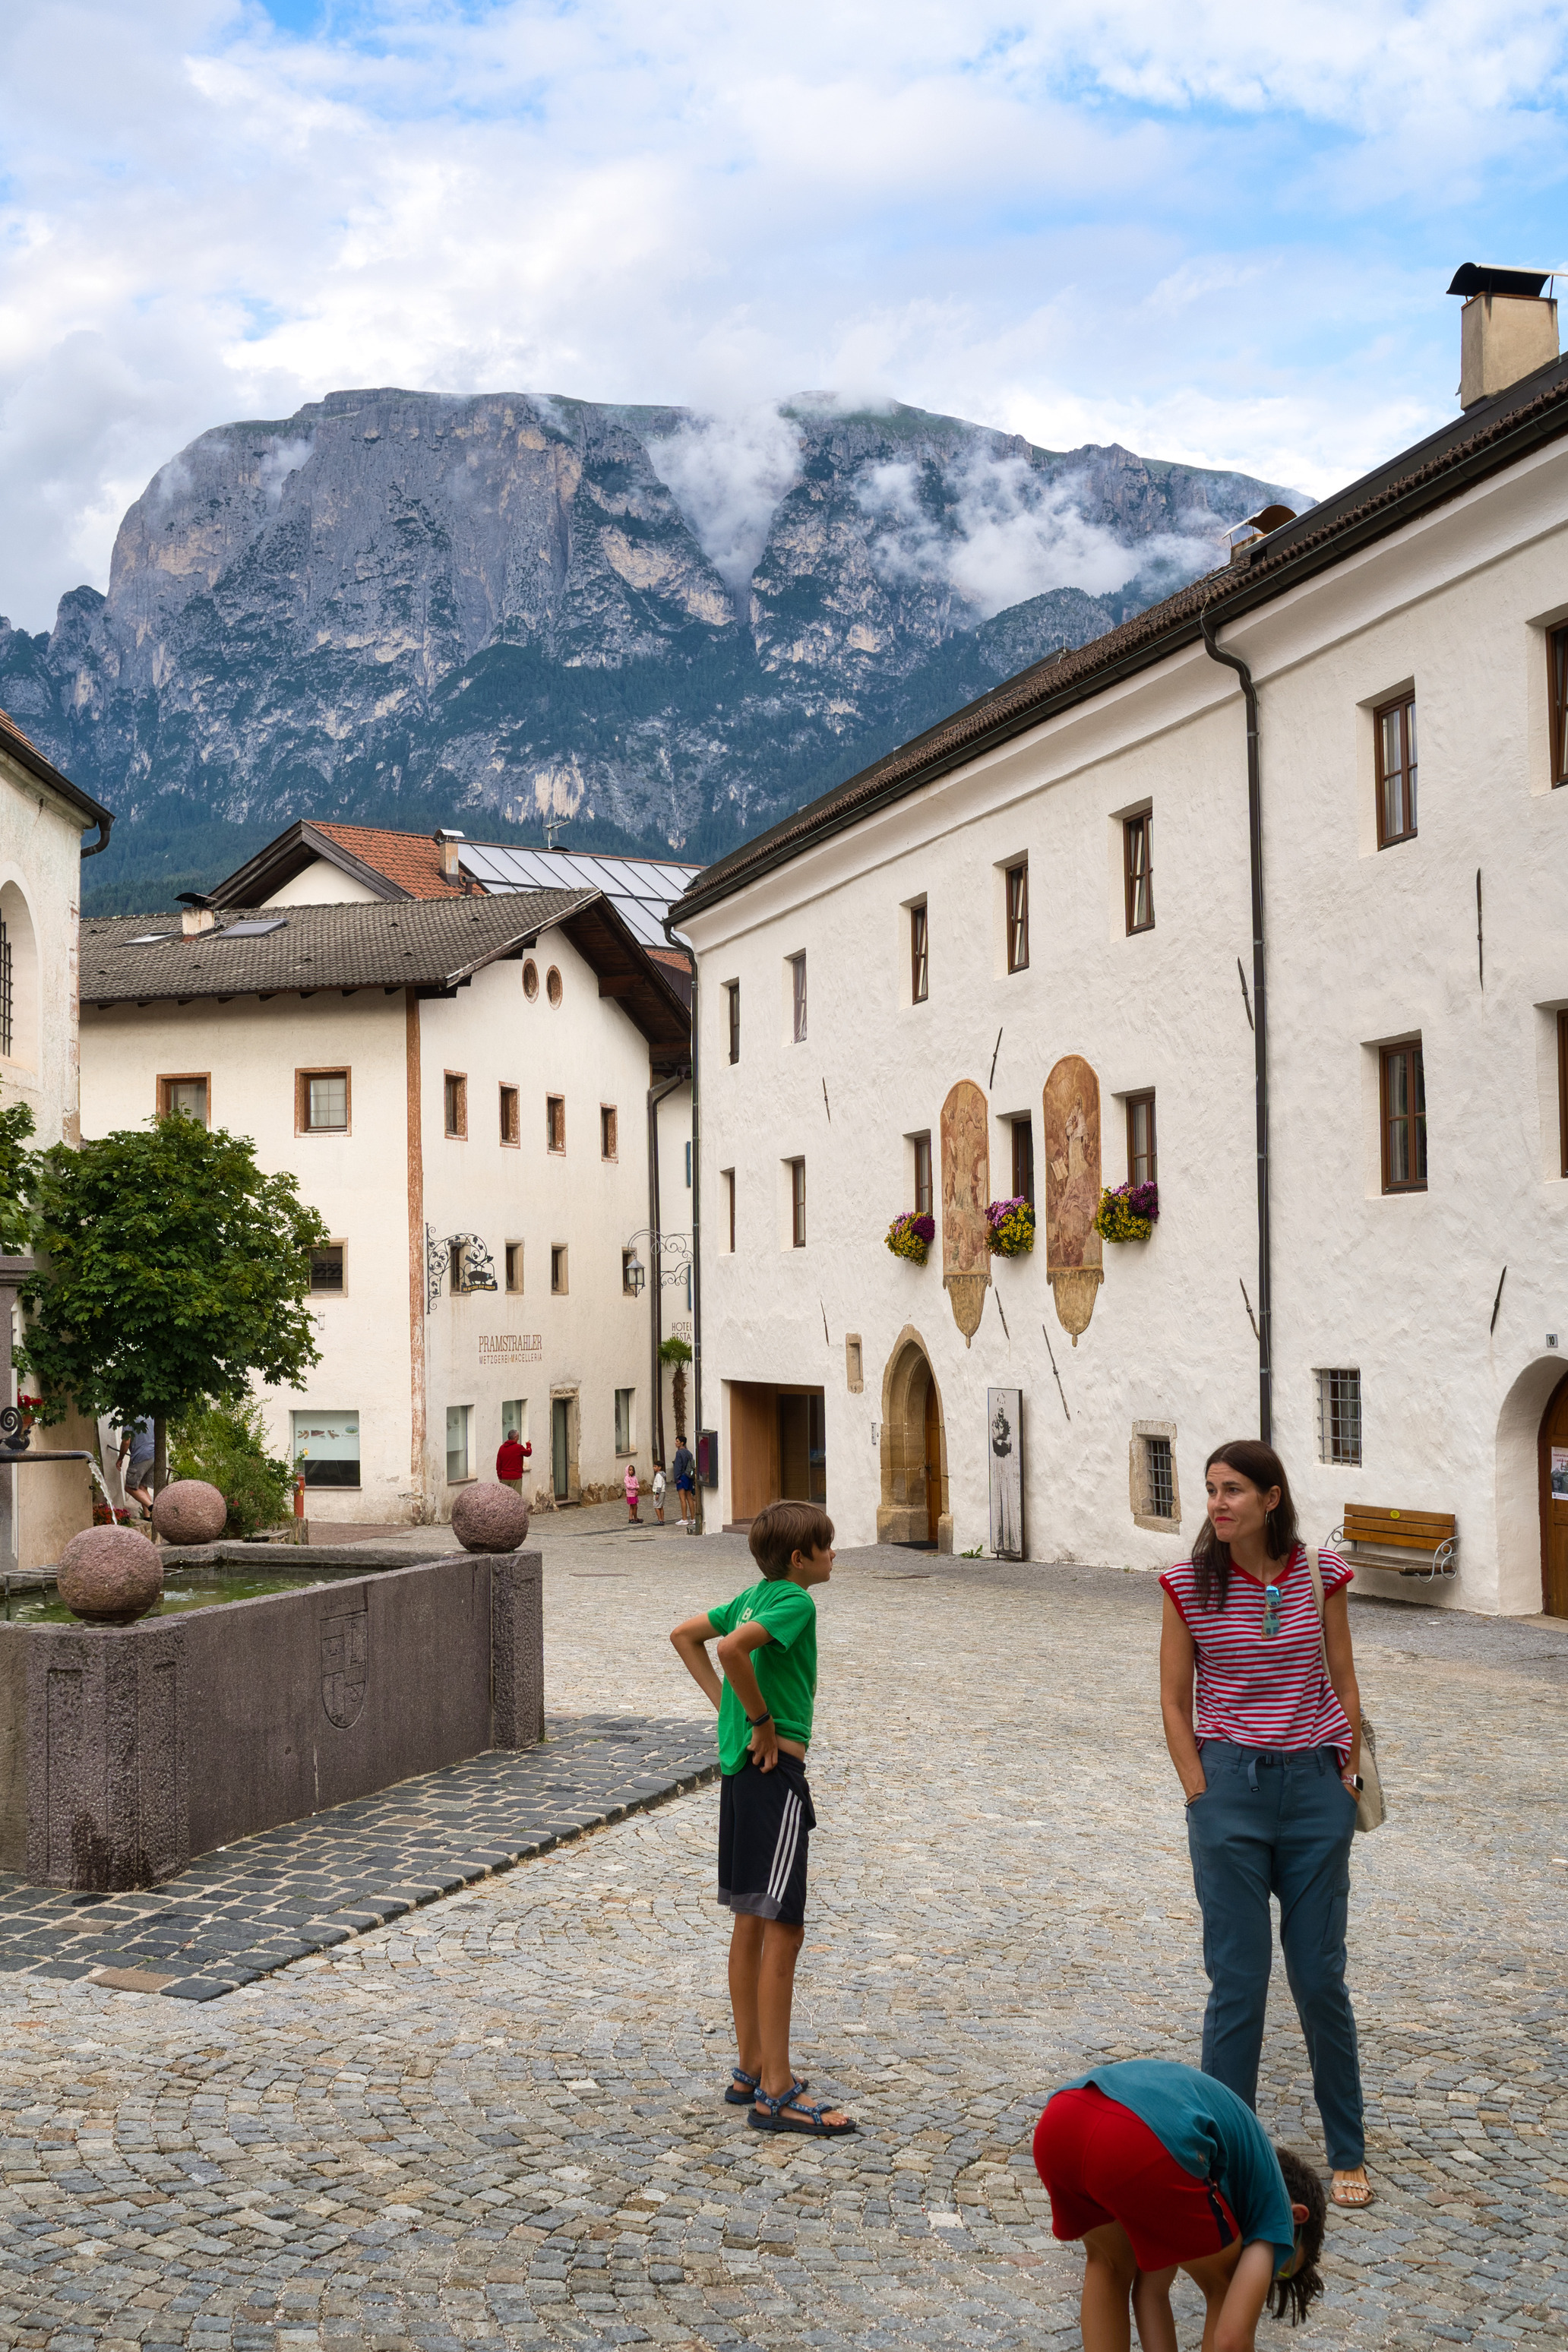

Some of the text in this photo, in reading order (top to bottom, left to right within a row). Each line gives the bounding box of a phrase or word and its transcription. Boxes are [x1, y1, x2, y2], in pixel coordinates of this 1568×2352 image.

[672, 1322, 692, 1332] HOTEL
[479, 1334, 542, 1353] PRAMSTRAHLER
[1548, 1336, 1555, 1345] 10
